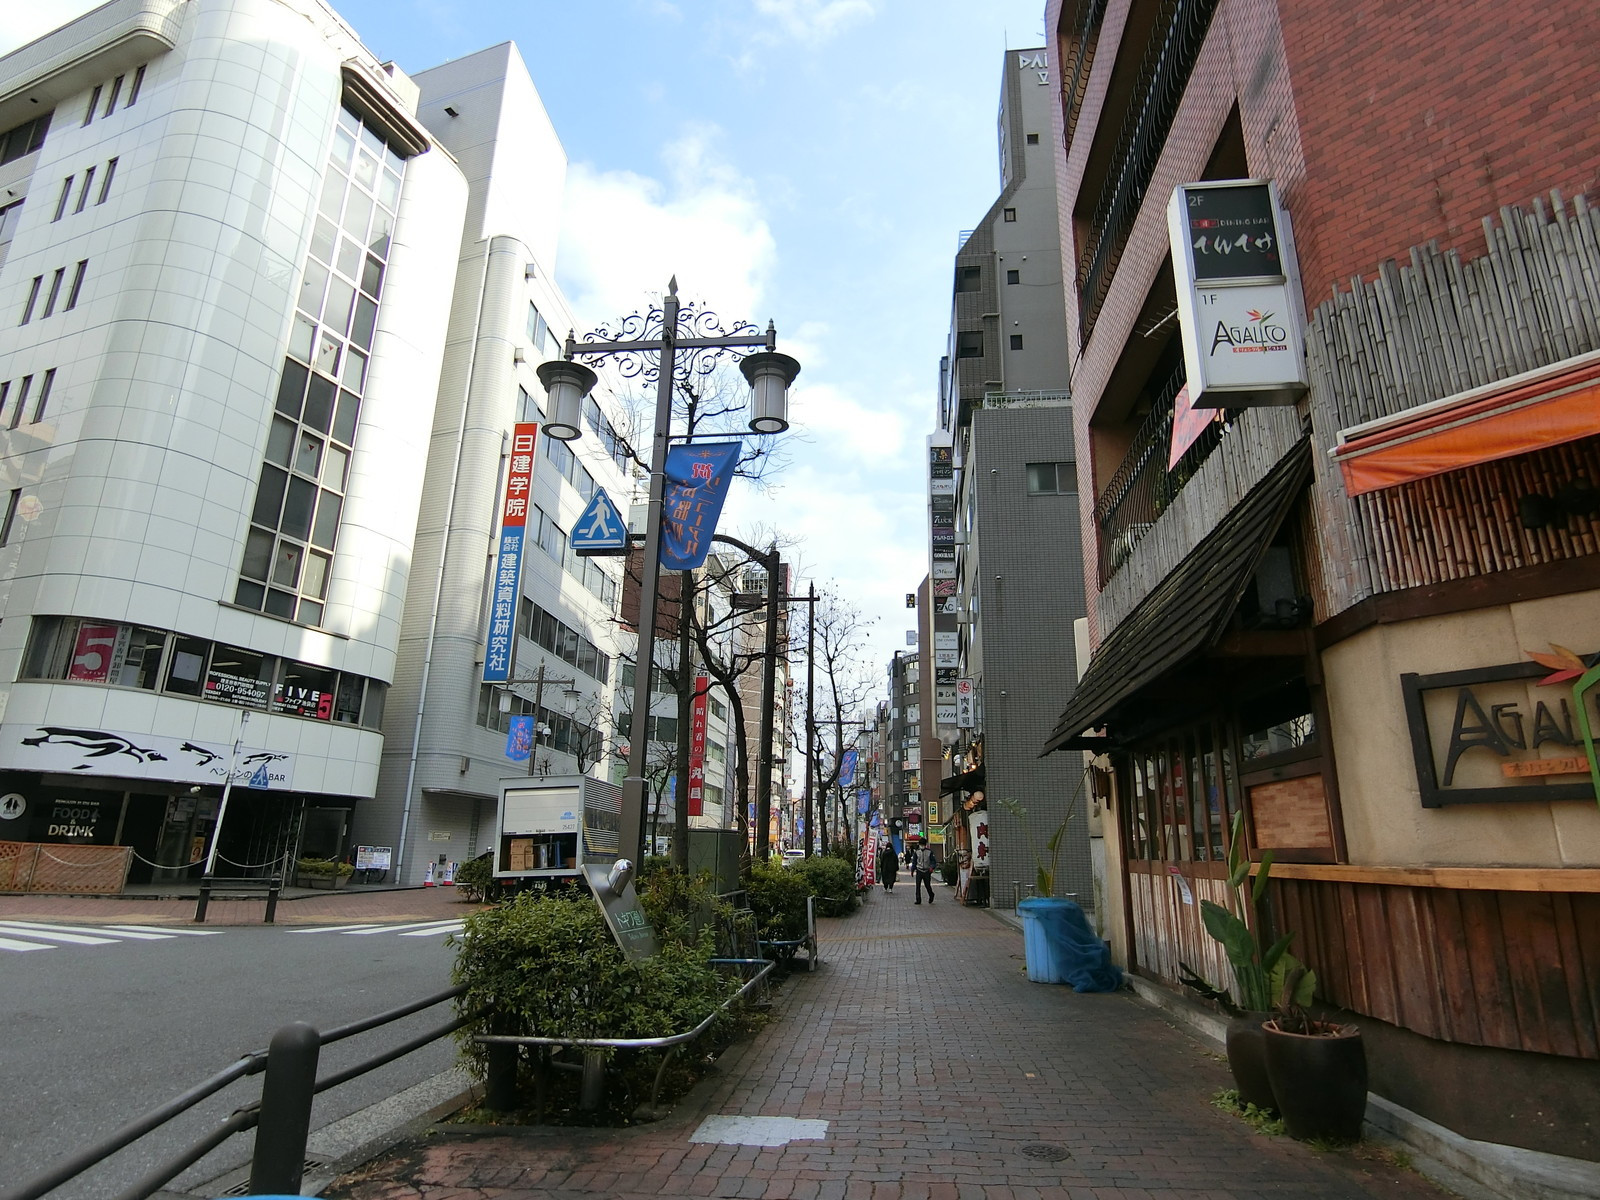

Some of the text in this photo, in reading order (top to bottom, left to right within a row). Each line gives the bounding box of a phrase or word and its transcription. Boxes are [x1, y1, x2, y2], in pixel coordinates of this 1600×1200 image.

[1188, 195, 1204, 207] 2F
[1202, 294, 1217, 305] 1F
[505, 434, 534, 517] 日建学院
[488, 553, 517, 672] 建築資料研究社
[936, 603, 954, 612] ZAC
[275, 683, 320, 702] FIVE
[960, 696, 970, 725] 肉寿司
[268, 773, 286, 781] BAR
[52, 807, 90, 820] FOOD
[48, 824, 95, 837] DRINK
